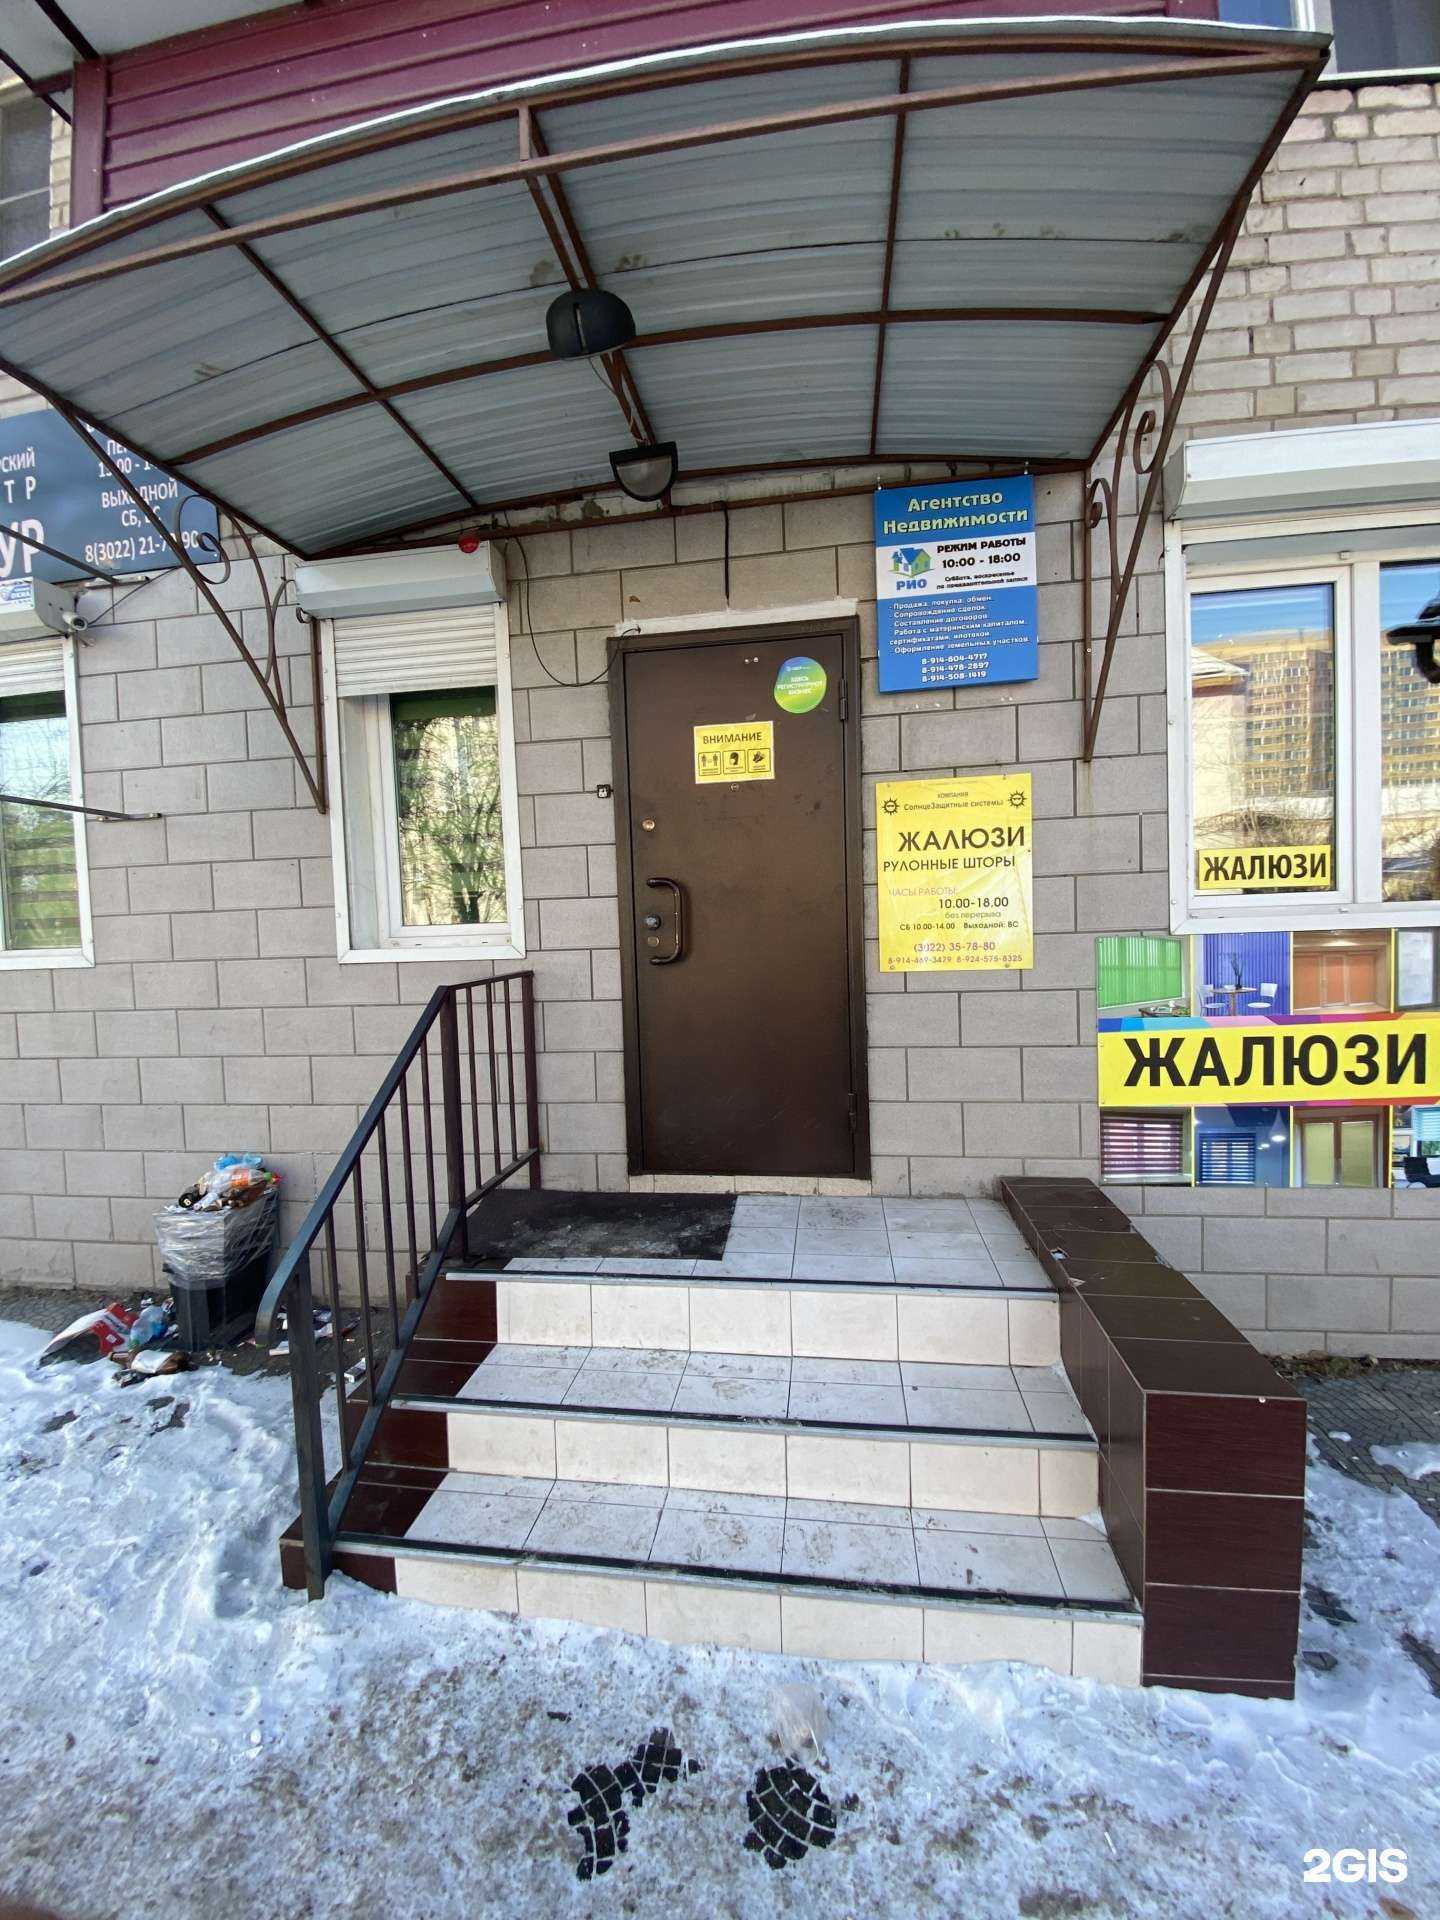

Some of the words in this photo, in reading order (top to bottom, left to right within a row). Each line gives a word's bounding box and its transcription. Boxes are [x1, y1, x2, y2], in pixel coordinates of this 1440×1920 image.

[907, 492, 1003, 513] Агентство
[883, 509, 1028, 535] Недвижимости
[84, 537, 136, 566] 8(3022)
[936, 541, 977, 554] РЕЖИМ
[980, 537, 1026, 549] РАБОТЫ
[942, 557, 976, 569] 10:00
[988, 552, 1021, 565] 18:00
[895, 578, 928, 591] РИО
[894, 627, 921, 636] Работа
[702, 731, 763, 745] ВНИМАНИЕ
[903, 801, 969, 812] СолнцеЗащитные
[970, 799, 1004, 808] системы
[897, 825, 1025, 852] ЖАЛЮЗИ
[883, 858, 959, 872] РУЛОННЫЕ
[963, 855, 1016, 870] ШТОРЫ
[1203, 852, 1328, 882] ЖАЛЮЗИ
[888, 887, 917, 897] ЧАСЫ
[939, 896, 1010, 909] 10.00-18.00
[944, 911, 960, 920] без
[913, 943, 946, 953] (3022)
[948, 941, 996, 952] 35-78-80
[1122, 1032, 1428, 1088] ЖАЛЮЗИ
